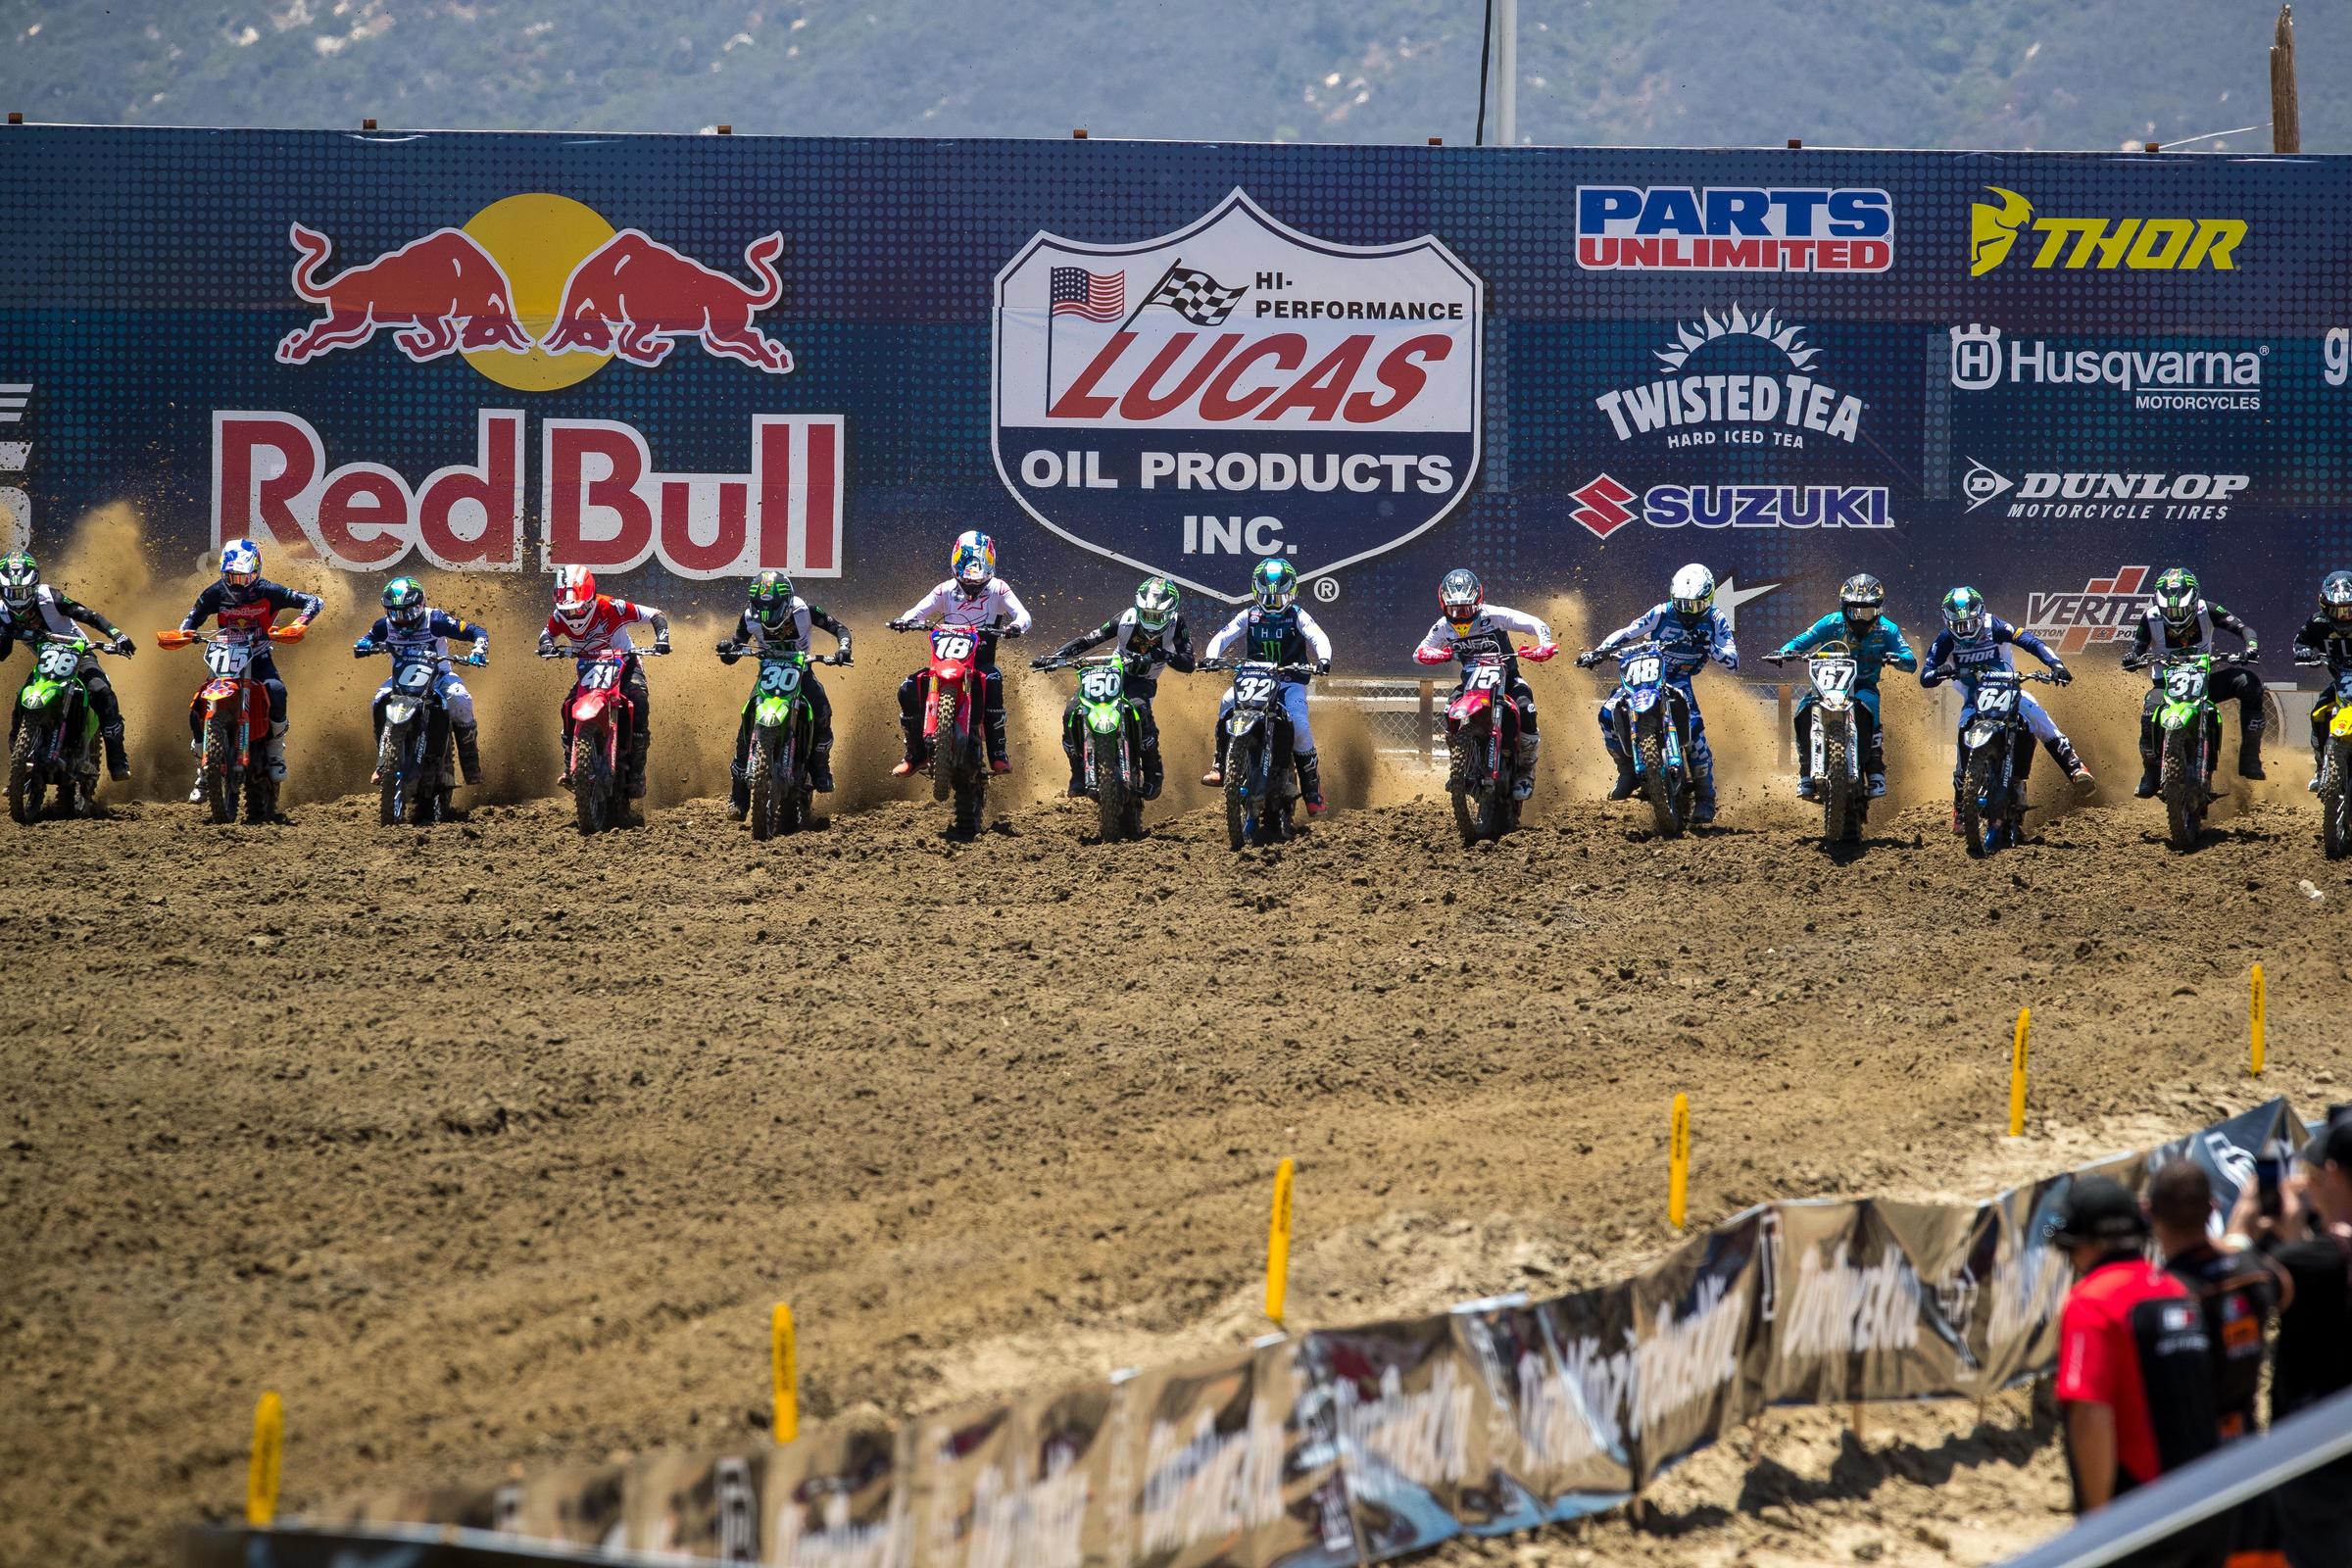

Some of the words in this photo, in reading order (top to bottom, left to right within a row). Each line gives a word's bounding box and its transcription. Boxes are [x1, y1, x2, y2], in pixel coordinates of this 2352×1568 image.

[1577, 186, 1892, 237] PARTS
[1577, 237, 1891, 270] UNLIMITED
[2032, 218, 2249, 270] THOR
[1255, 271, 1294, 290] HI-
[1255, 300, 1464, 320] PERFORMANCE
[2010, 340, 2260, 392] Husqvarna
[2324, 326, 2352, 386] g
[1046, 331, 1453, 424] LUCAS
[1595, 374, 1781, 441] TWISTED
[1787, 374, 1862, 443] TEA
[2134, 396, 2261, 411] MOTORCYCLES
[1667, 432, 1716, 449] HARD
[1725, 430, 1764, 444] ICED
[1773, 431, 1804, 449] TEA
[1020, 450, 1118, 490] OIL
[1141, 451, 1453, 494] PRODUCTS
[210, 409, 524, 572] Red
[541, 414, 843, 579] Bull
[2015, 472, 2250, 501] DUNLOP
[1642, 484, 1890, 529] SUZUKI
[2006, 503, 2151, 519] MOTORCYCLE
[2165, 505, 2230, 520] TIRES
[1183, 515, 1298, 556] INC.
[2025, 593, 2154, 627] VERTE
[208, 646, 250, 673] 115
[936, 637, 971, 661] 18
[1958, 649, 1996, 663] THOR
[38, 650, 78, 677] 38
[398, 663, 433, 687] 6
[580, 664, 619, 689] 41
[1625, 658, 1660, 686] 48
[760, 665, 801, 692] 30
[1081, 672, 1121, 699] 150
[1236, 677, 1272, 703] 32
[1462, 665, 1500, 690] 75
[1817, 665, 1853, 690] 67
[2168, 672, 2205, 698] 31
[1977, 687, 2010, 712] 64
[416, 730, 426, 764] DUNLOP
[1262, 744, 1271, 777] DUNLP
[2002, 754, 2011, 788] DUNLOP
